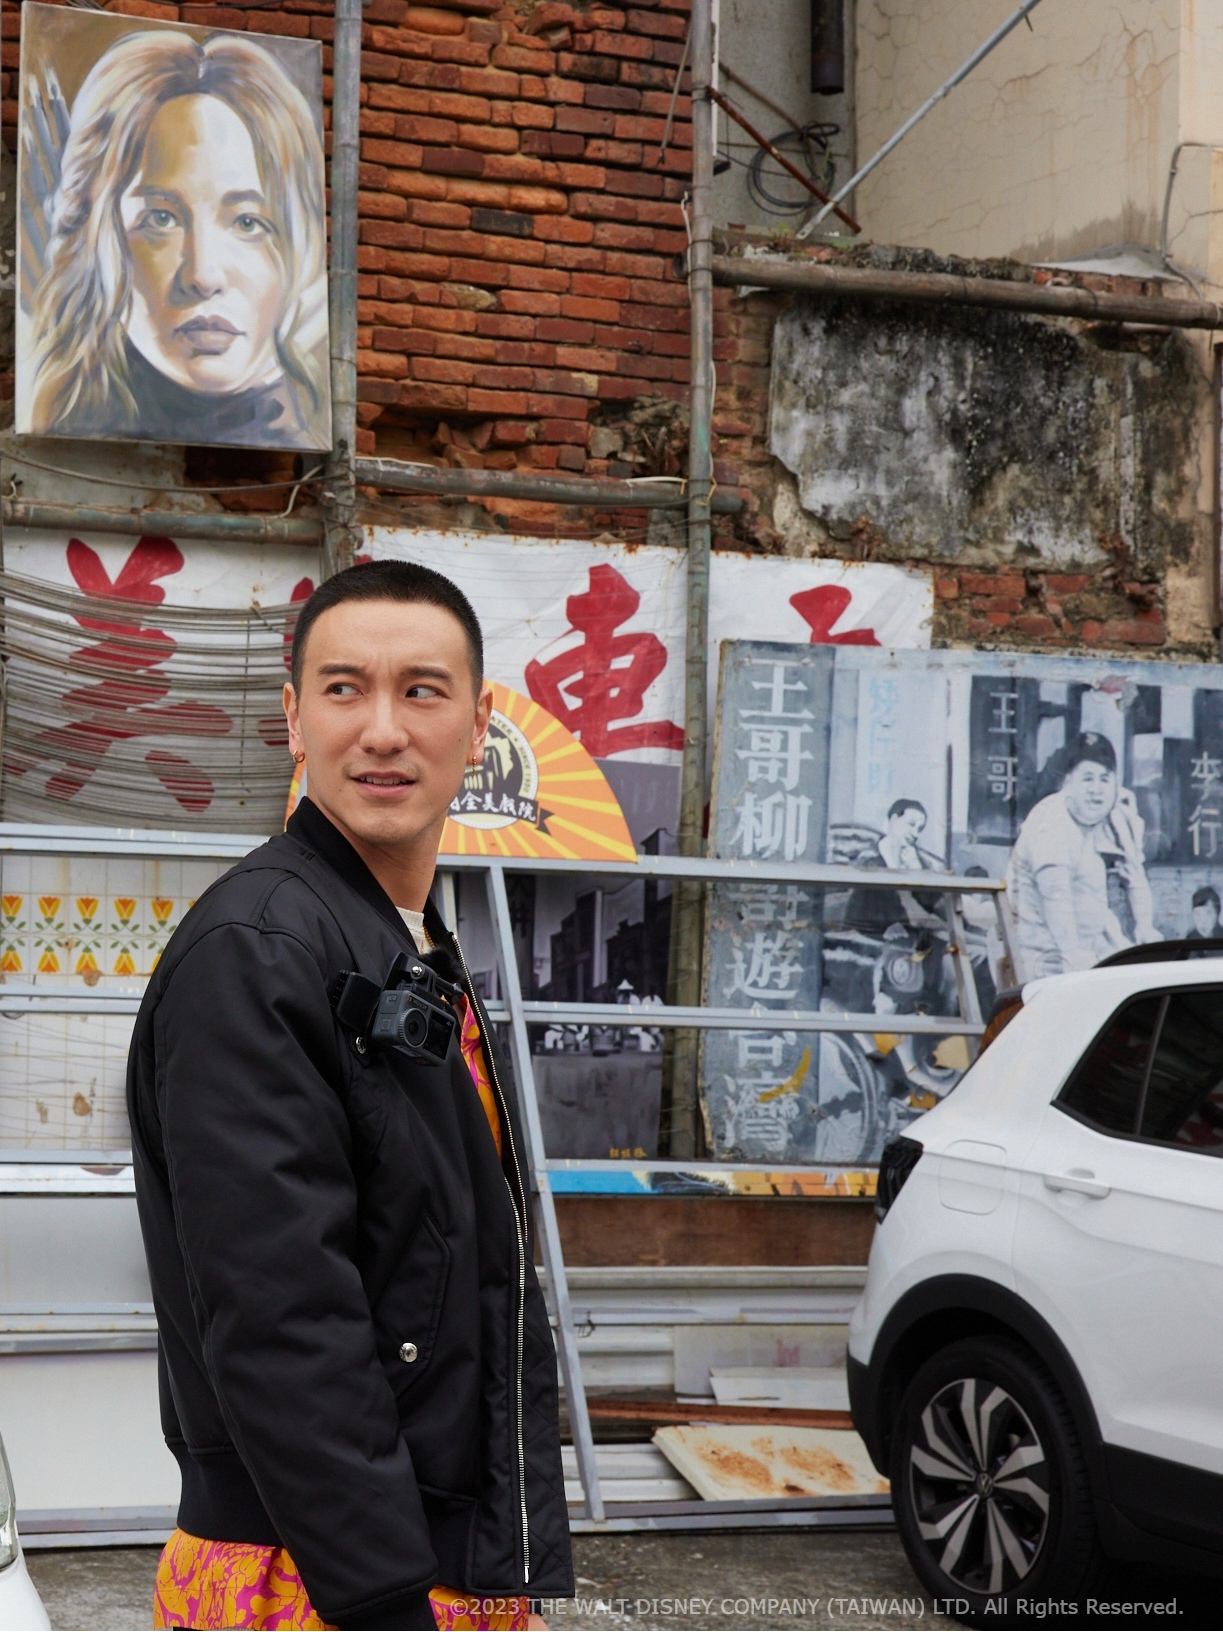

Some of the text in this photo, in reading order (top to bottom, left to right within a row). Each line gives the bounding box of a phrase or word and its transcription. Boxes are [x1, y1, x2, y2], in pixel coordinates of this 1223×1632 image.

[490, 715, 513, 735] ATER
[987, 691, 1018, 802] 王哥
[1187, 751, 1223, 857] 李行
